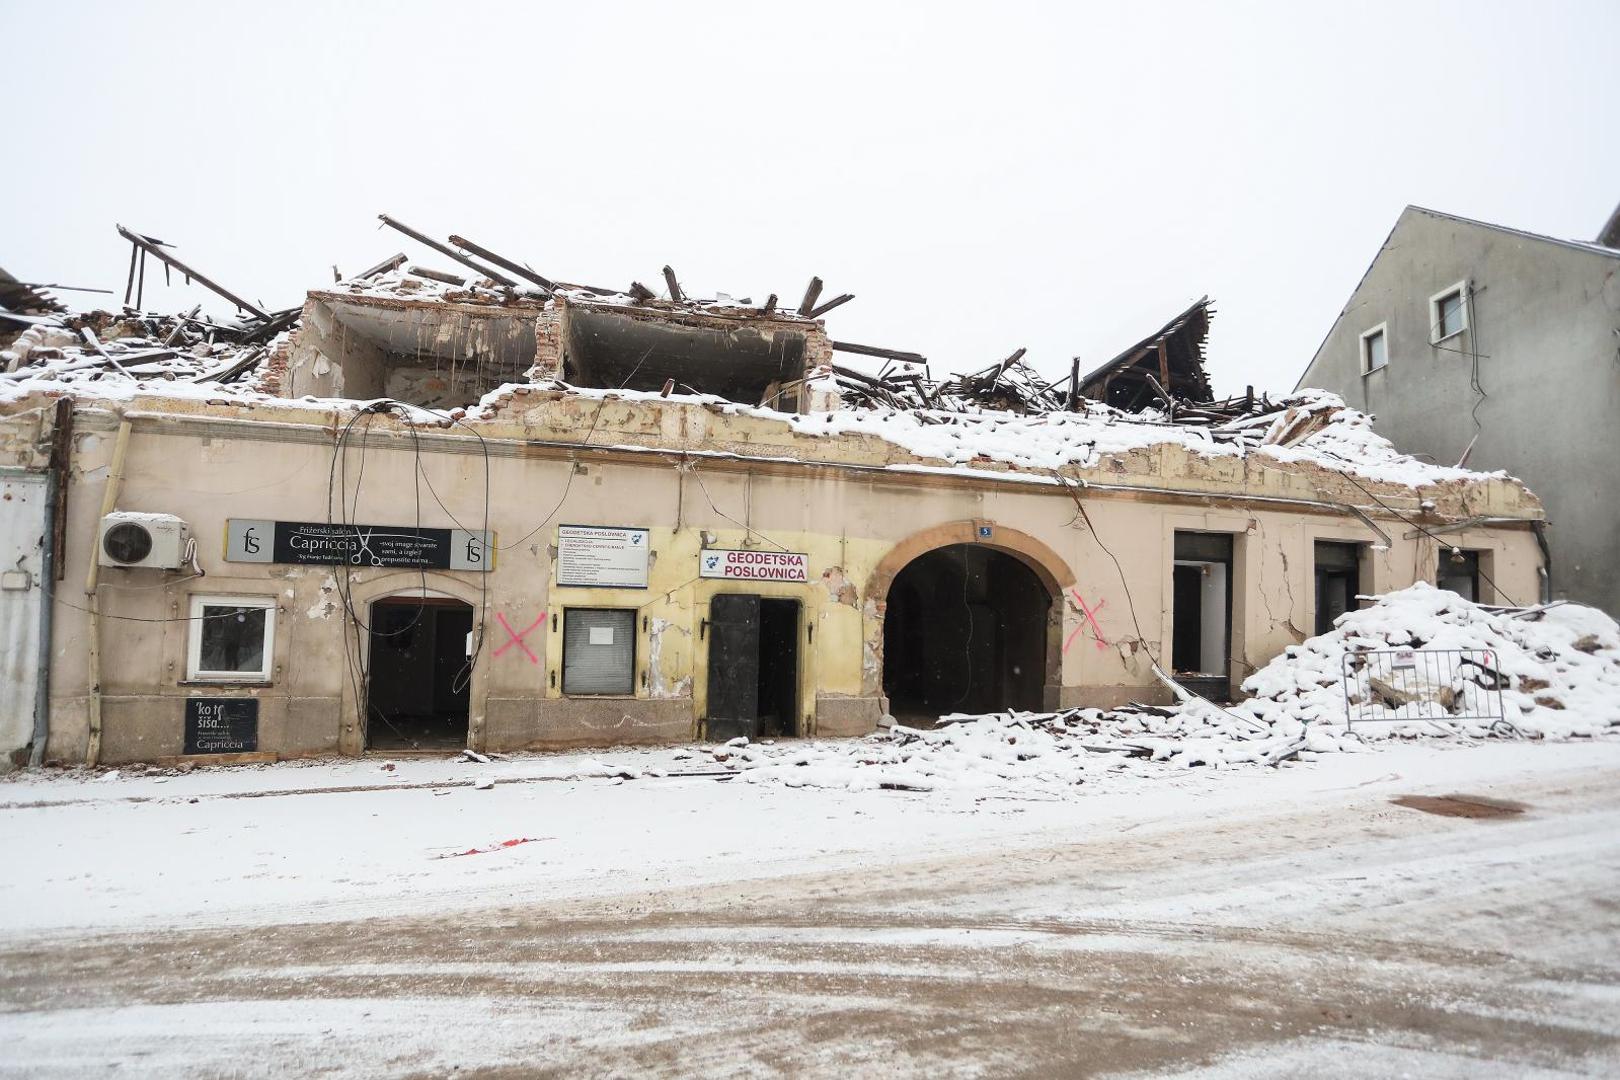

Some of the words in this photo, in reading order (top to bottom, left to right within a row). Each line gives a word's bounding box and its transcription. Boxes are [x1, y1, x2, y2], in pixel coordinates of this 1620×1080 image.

[289, 535, 358, 553] Capriccia
[727, 552, 803, 566] GEODETSKA
[724, 565, 805, 579] POSLOVNICA
[196, 740, 243, 751] Capriccia
